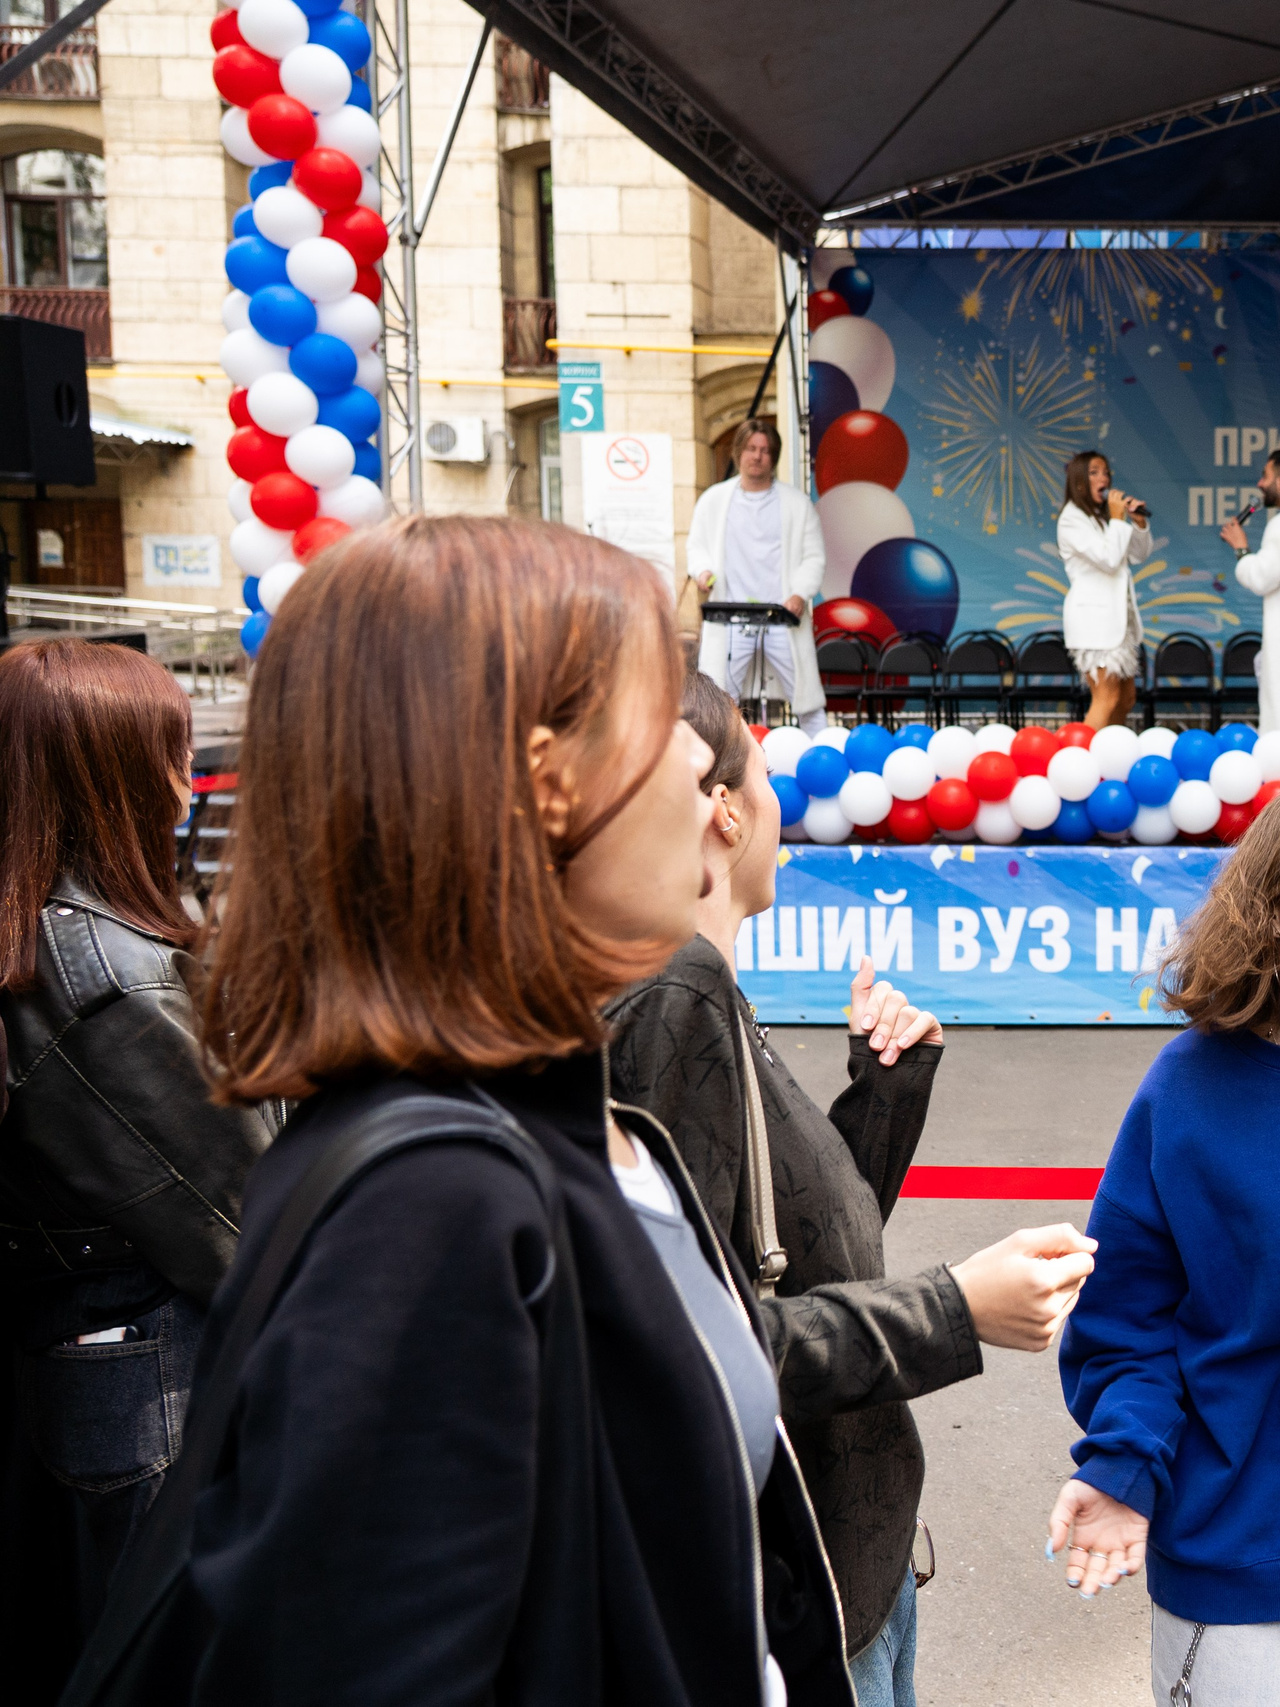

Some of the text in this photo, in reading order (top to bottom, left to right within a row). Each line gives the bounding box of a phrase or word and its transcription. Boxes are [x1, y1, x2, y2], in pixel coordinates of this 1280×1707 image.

[570, 385, 595, 428] 5
[735, 888, 914, 973] ШИЙ
[937, 905, 1072, 973] ВУЗ
